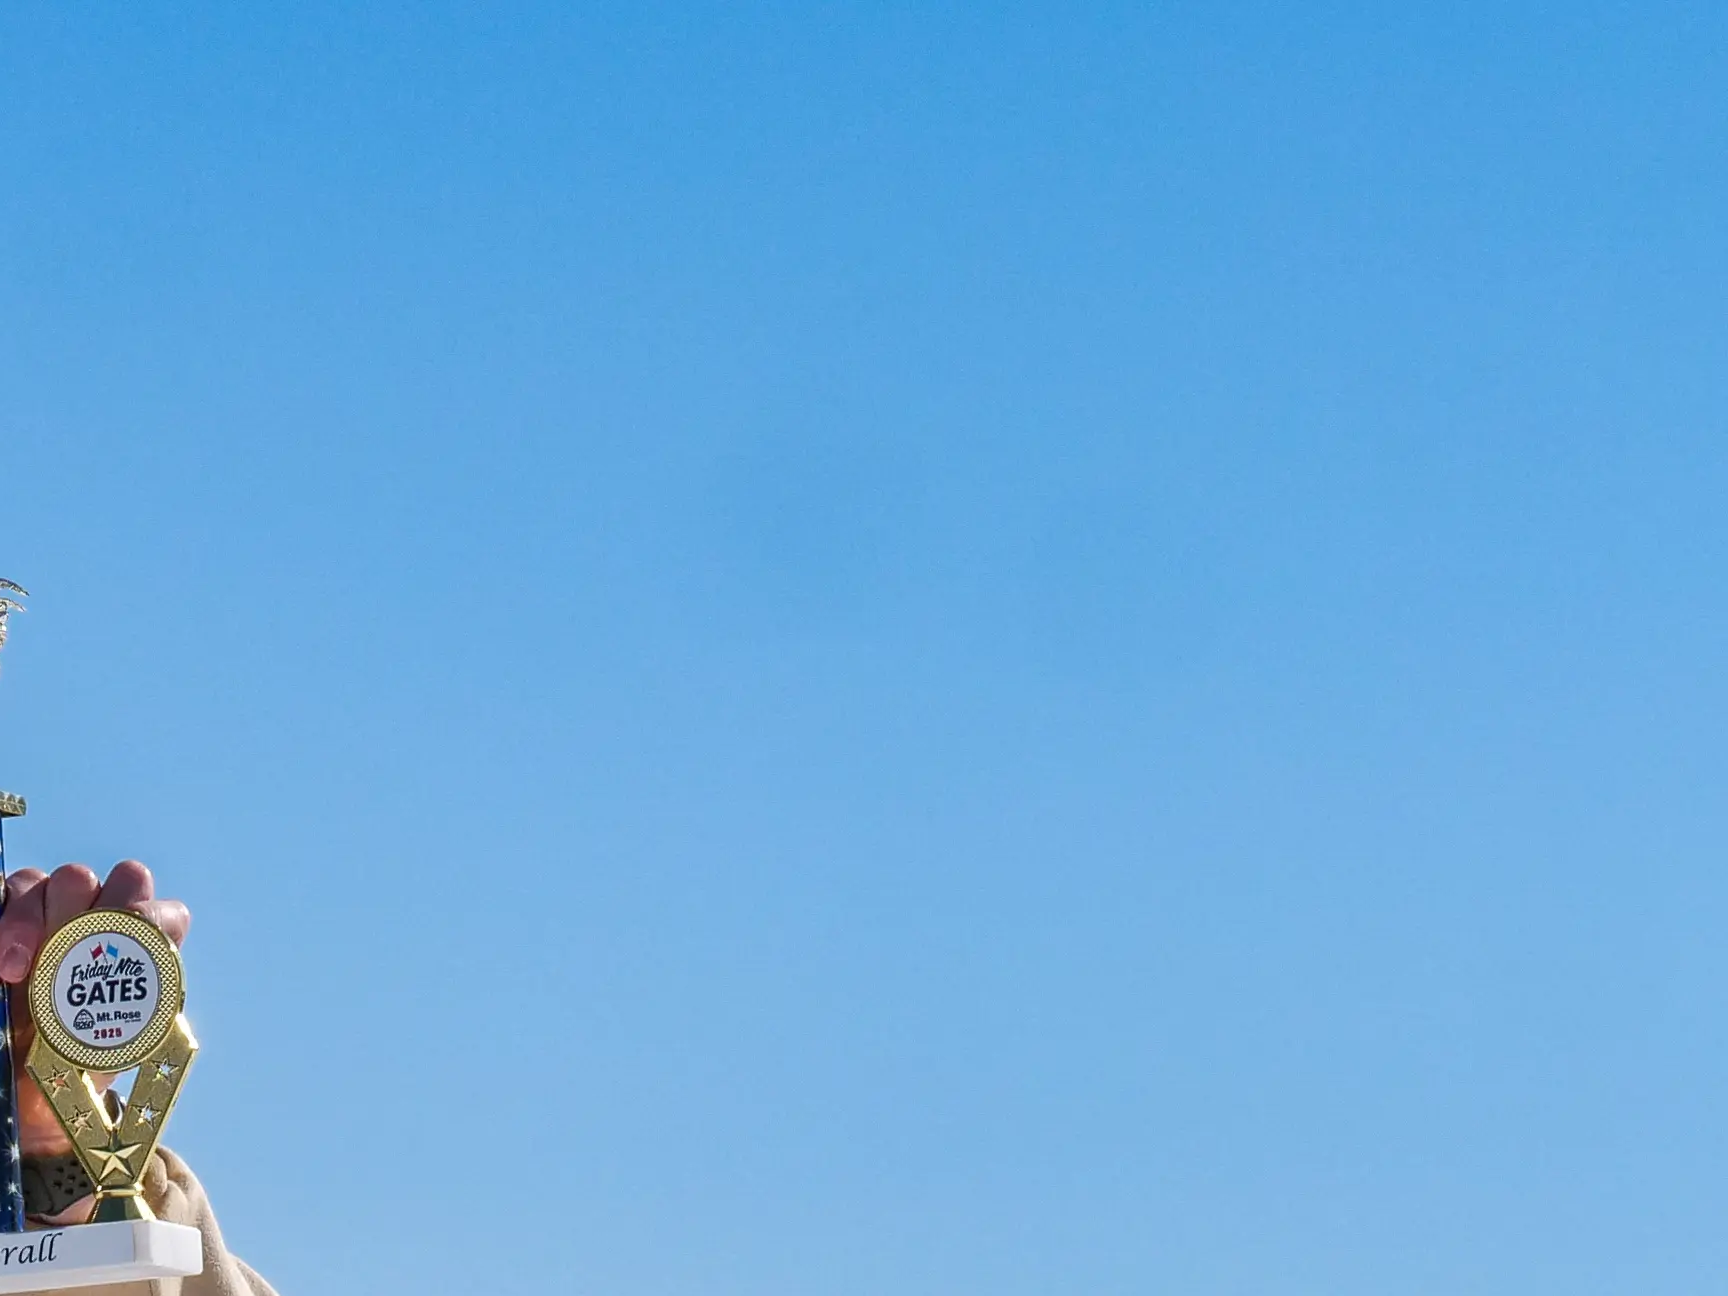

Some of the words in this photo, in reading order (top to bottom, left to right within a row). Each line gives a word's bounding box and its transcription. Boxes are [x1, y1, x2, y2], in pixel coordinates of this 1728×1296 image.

[71, 960, 114, 985] Friday
[114, 957, 146, 977] Nite
[67, 977, 148, 1007] GATES
[96, 1012, 114, 1022] Mt.
[114, 1010, 142, 1021] Rose
[93, 1027, 123, 1040] 2025
